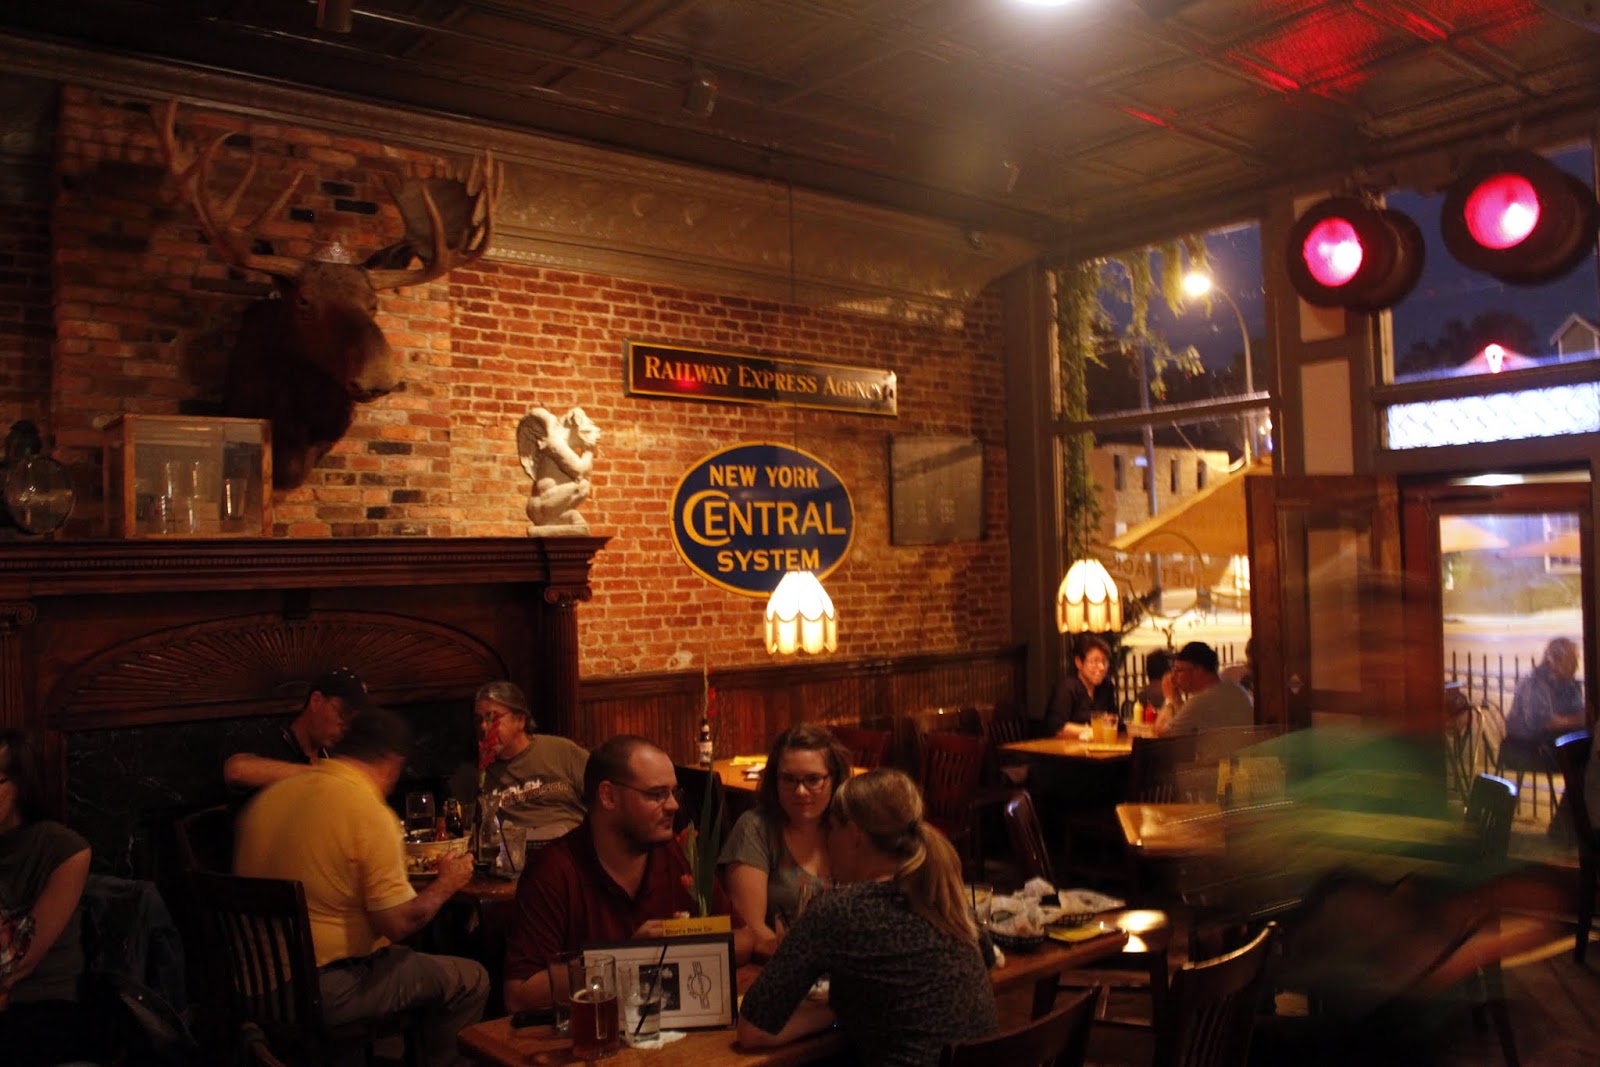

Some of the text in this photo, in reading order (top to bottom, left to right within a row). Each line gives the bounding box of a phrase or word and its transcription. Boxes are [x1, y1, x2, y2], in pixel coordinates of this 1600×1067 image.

[644, 355, 731, 386] RAILWAY
[738, 364, 818, 394] EXPRESS
[709, 464, 820, 488] NEW YORK
[682, 489, 847, 547] CENTRAL
[716, 548, 819, 573] SYSTEM
